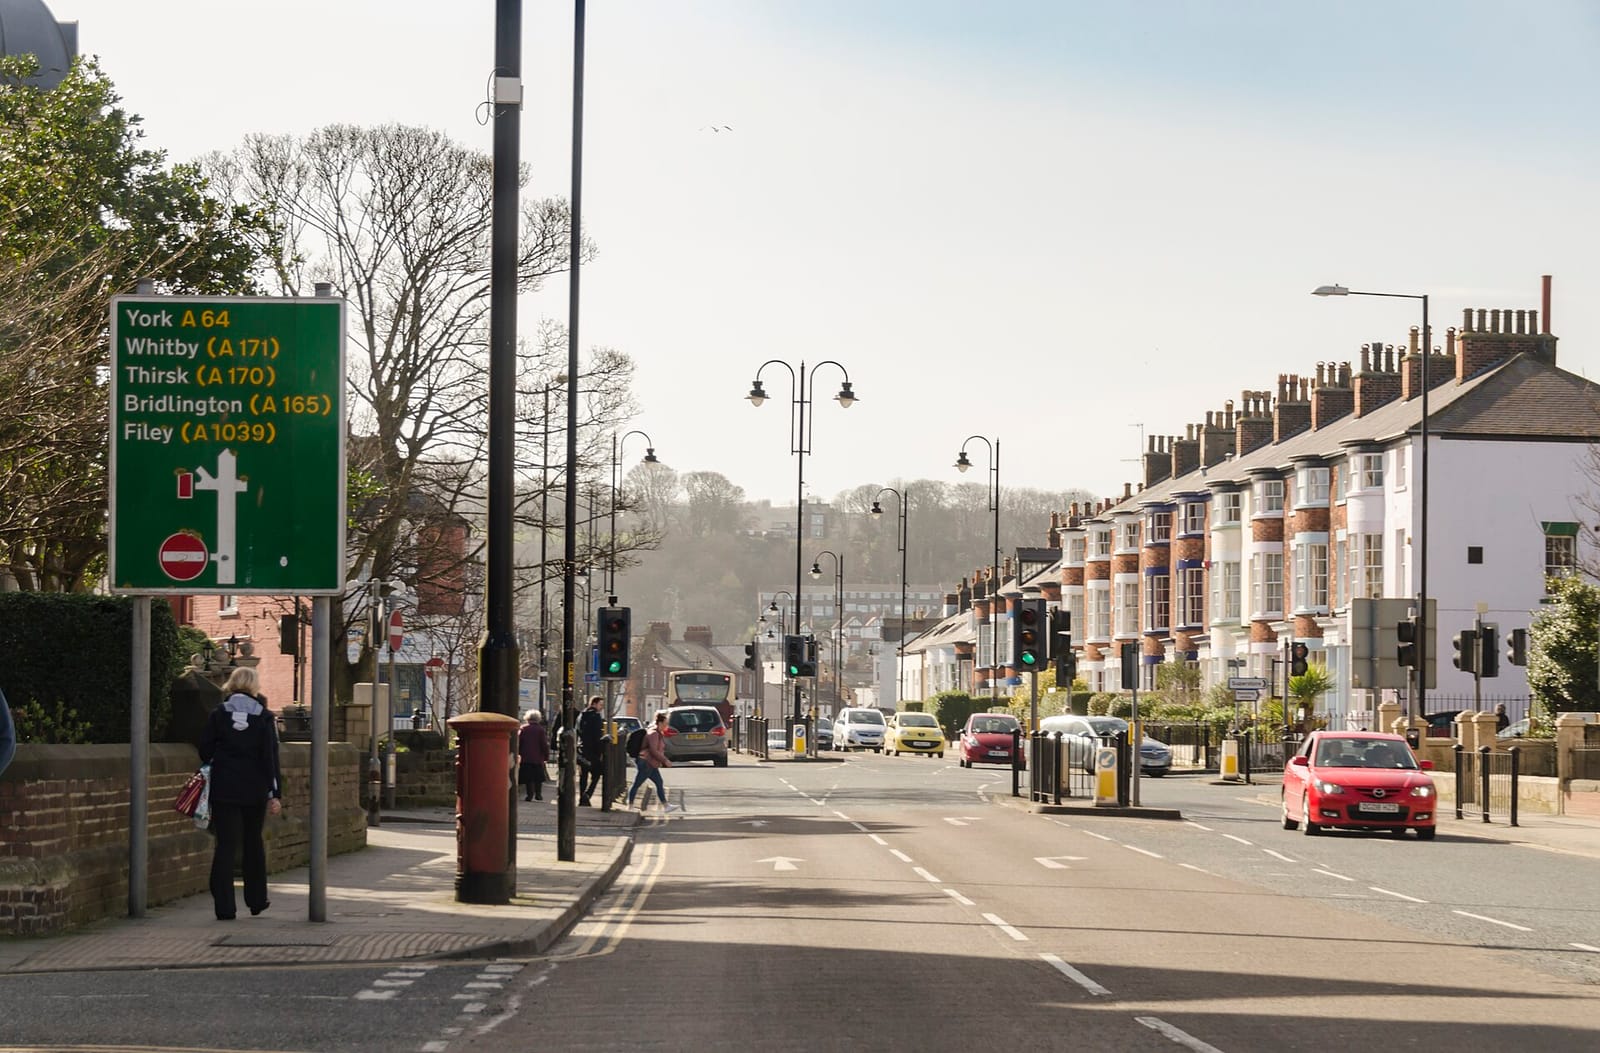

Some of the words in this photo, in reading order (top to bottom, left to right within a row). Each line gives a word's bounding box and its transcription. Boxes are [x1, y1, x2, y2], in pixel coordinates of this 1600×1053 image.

[126, 309, 173, 327] York
[181, 310, 196, 327] A
[201, 310, 230, 328] 64
[125, 338, 199, 359] Whitby
[125, 366, 190, 384] Thirsk
[125, 394, 243, 417] Bridlington
[124, 422, 174, 444] Filey
